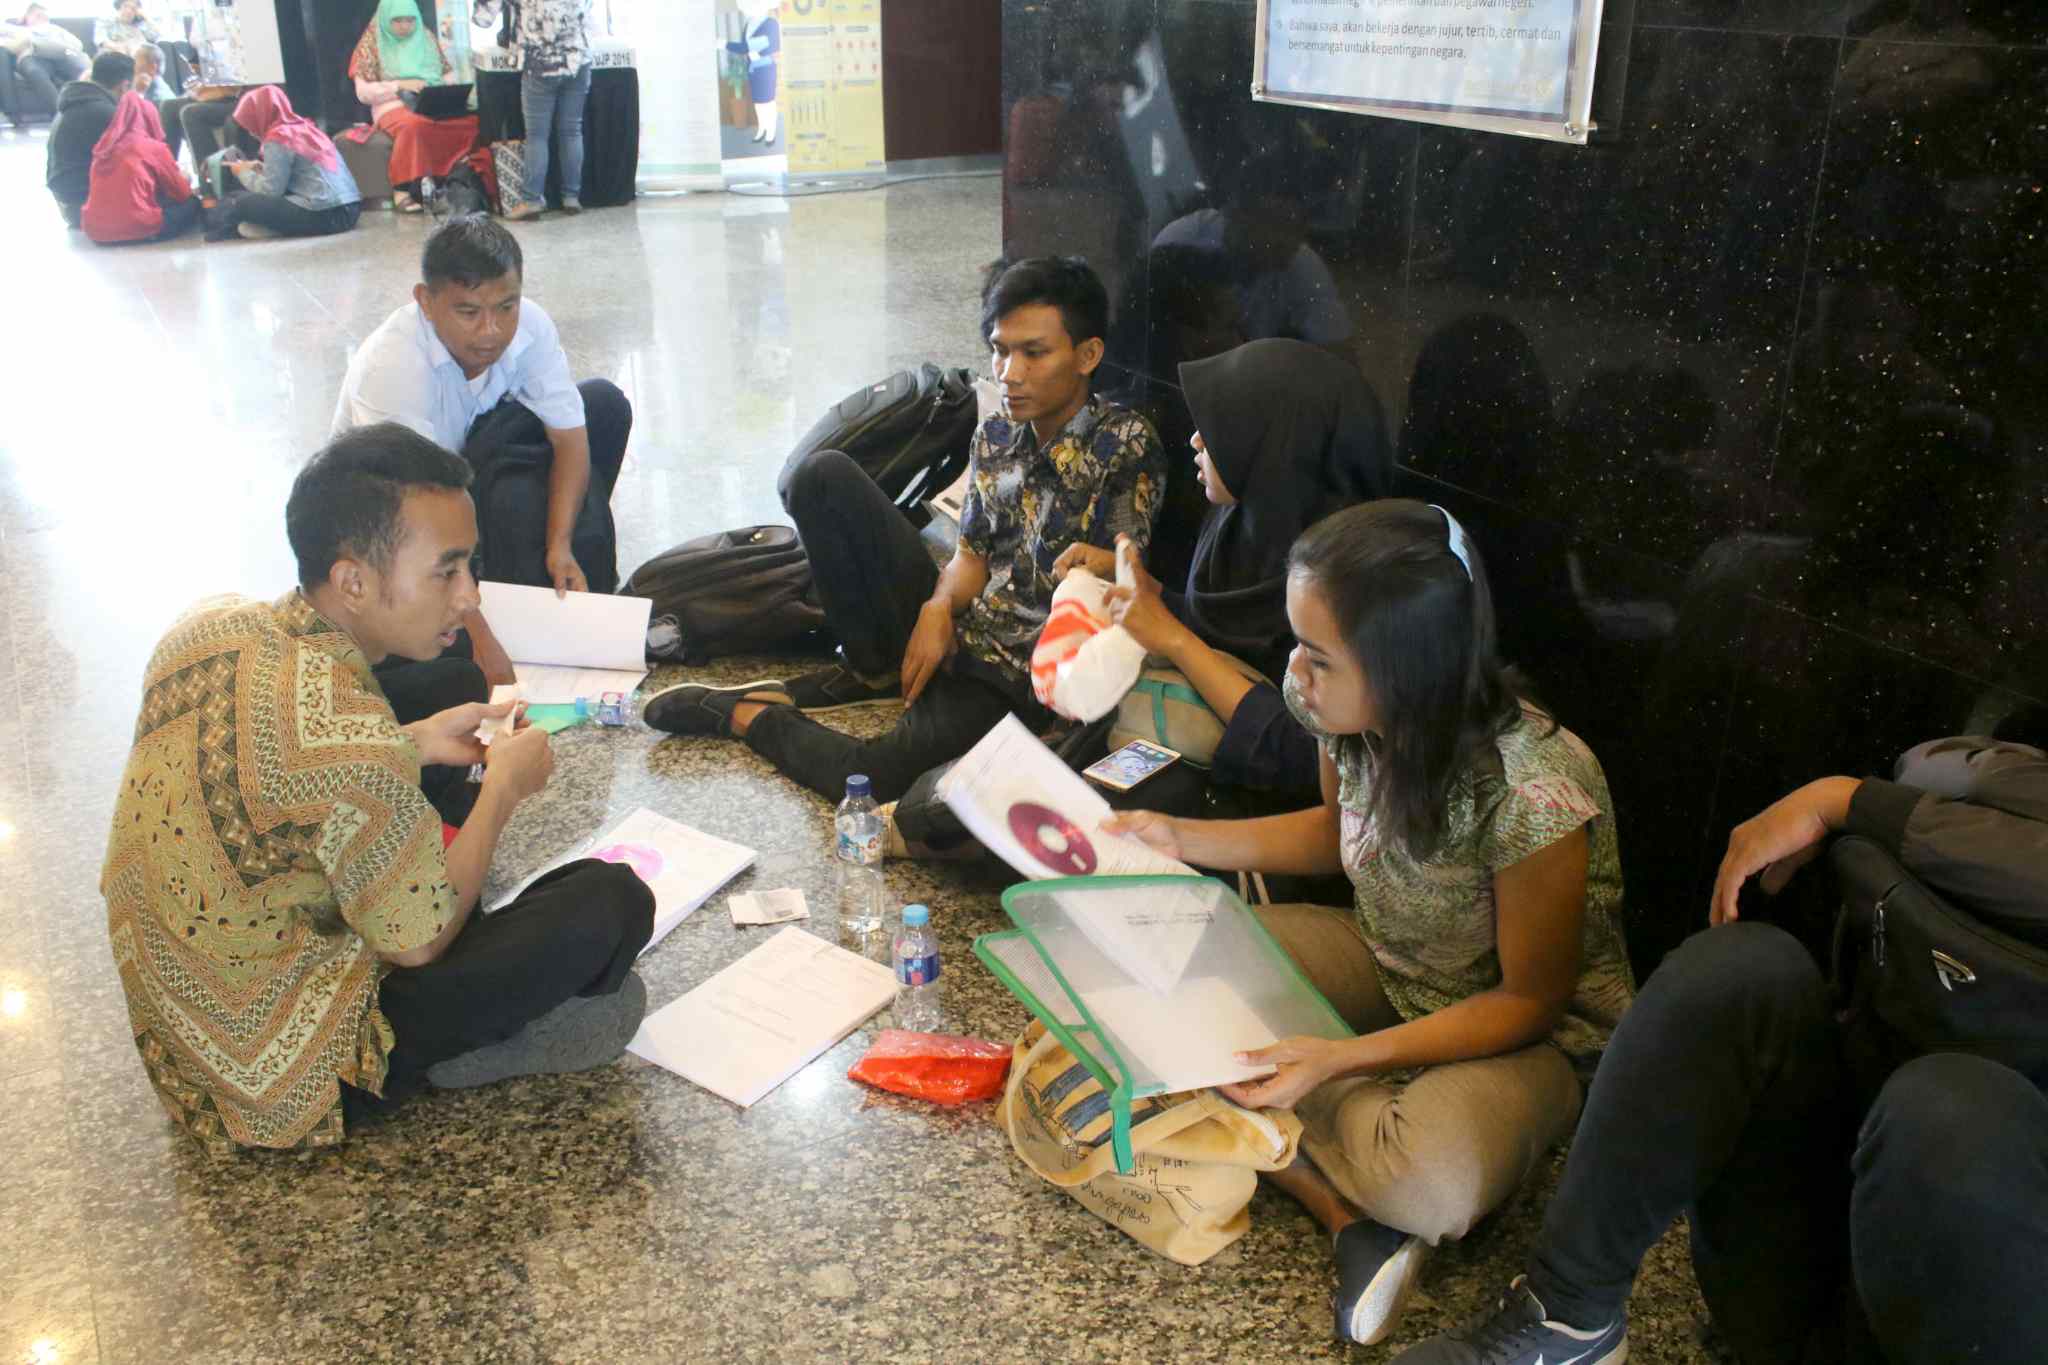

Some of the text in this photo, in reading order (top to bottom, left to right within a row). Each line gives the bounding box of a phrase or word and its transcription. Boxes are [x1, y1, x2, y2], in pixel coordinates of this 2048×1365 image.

[1342, 20, 1364, 33] akan
[1365, 20, 1399, 36] bekerja
[1401, 22, 1437, 38] dengan
[1500, 26, 1538, 40] cermat
[1540, 26, 1560, 40] dan
[1288, 39, 1343, 54] bersemangat
[1344, 41, 1370, 53] untuk
[1371, 41, 1429, 58] kepentingan
